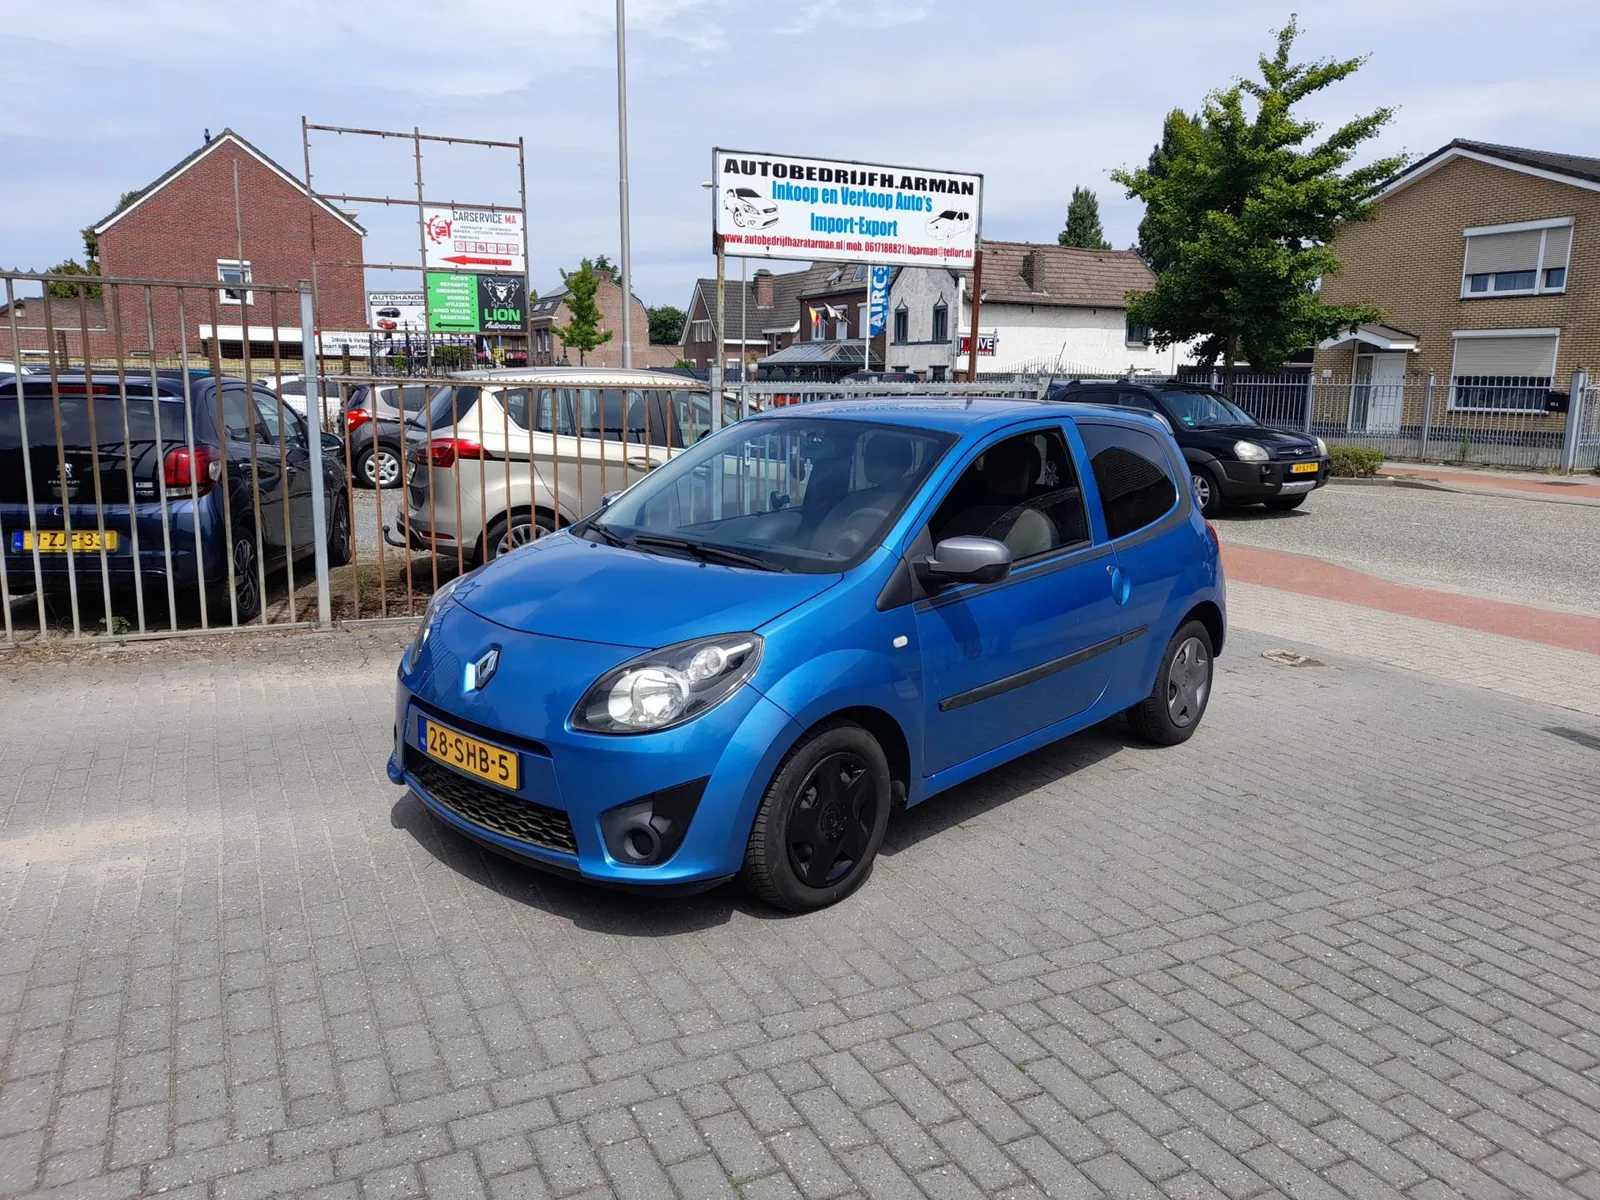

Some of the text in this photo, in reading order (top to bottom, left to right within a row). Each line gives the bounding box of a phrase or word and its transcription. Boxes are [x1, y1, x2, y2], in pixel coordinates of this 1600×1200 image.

[772, 180, 933, 212] Inkoop en Verkoop Auto's
[453, 211, 516, 224] CARSERVICE MA
[810, 212, 898, 237] Import-Export
[846, 241, 863, 251] mob.
[484, 308, 520, 321] LION
[485, 321, 521, 329] Autoservice
[429, 726, 509, 781] 28-SHB-5
